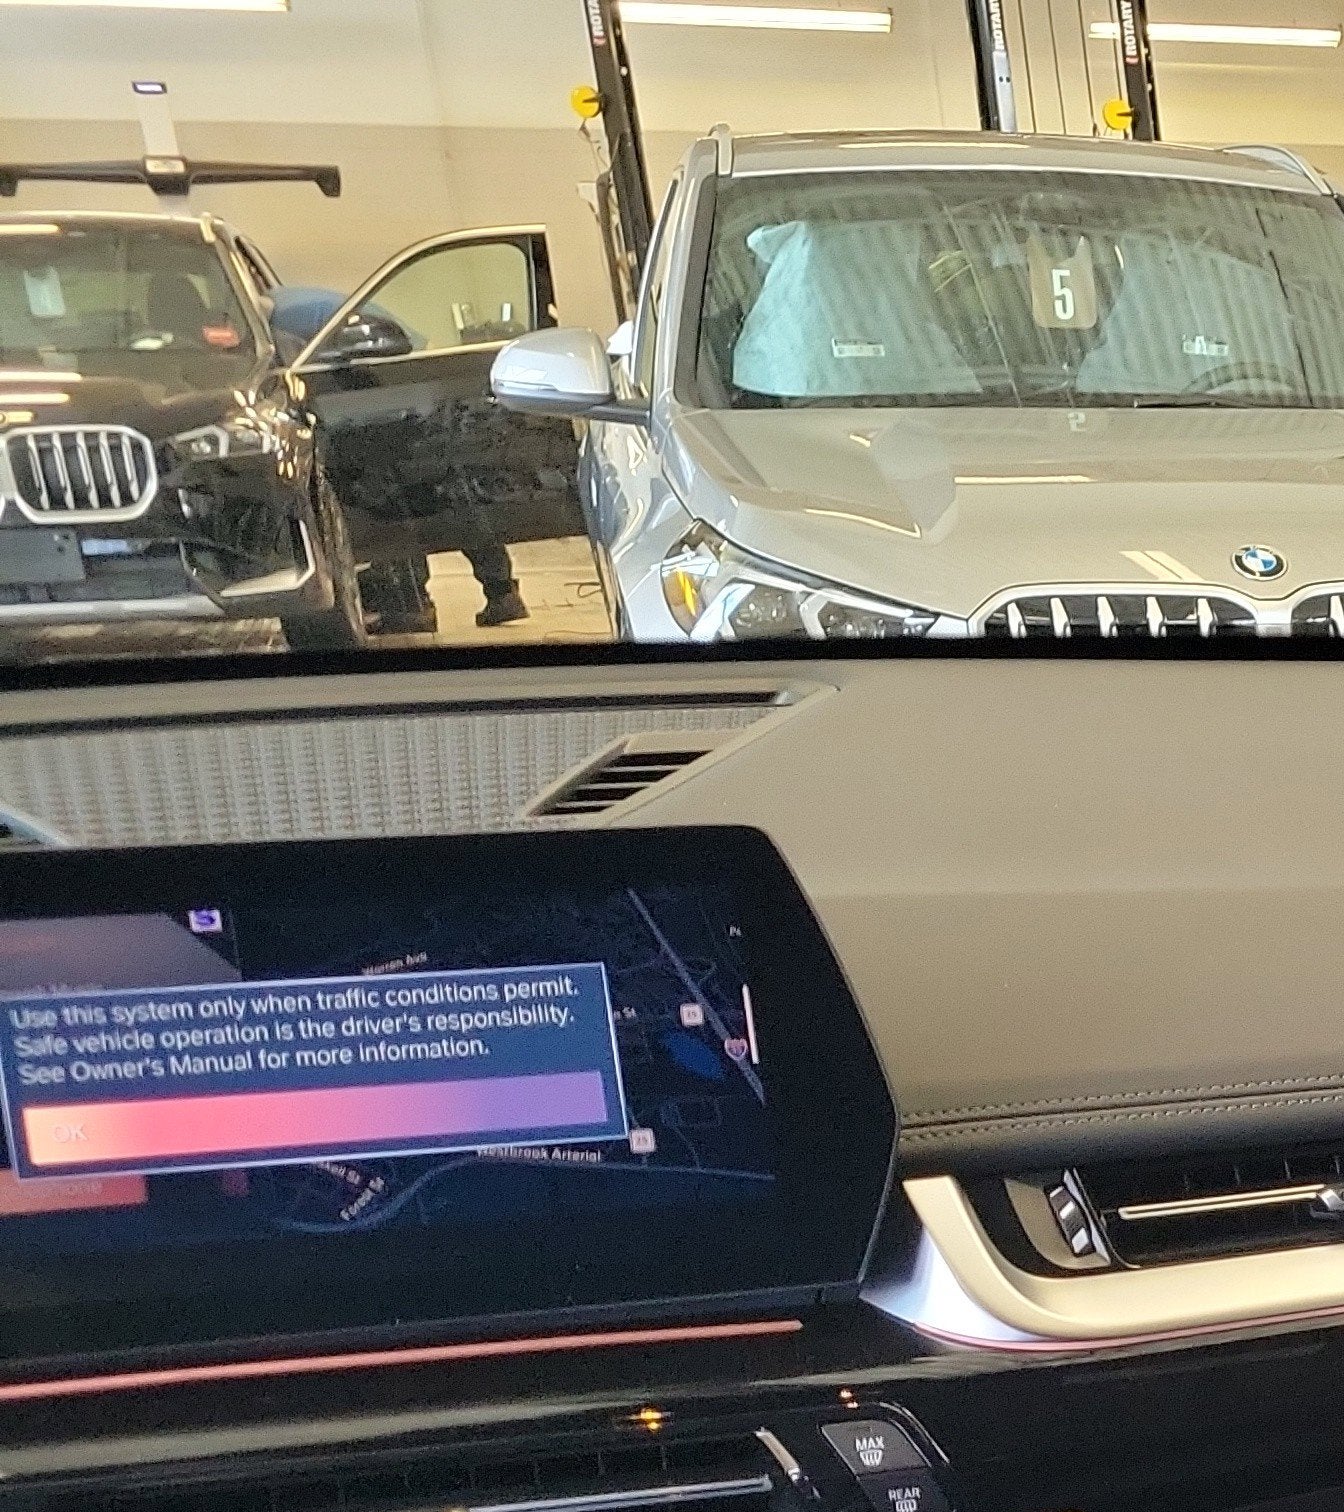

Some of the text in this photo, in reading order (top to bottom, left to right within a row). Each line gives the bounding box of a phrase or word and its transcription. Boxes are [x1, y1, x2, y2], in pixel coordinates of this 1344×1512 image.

[1052, 269, 1074, 320] 5
[10, 975, 579, 1030] Use this system only when traffic conditions permit.
[14, 1002, 575, 1058] Safe vehicle operation is the driver's responsibility.
[18, 1035, 489, 1086] See Owner's Manual for more information.
[53, 1123, 88, 1144] OK
[855, 1436, 885, 1451] MAX
[888, 1486, 921, 1501] REAR
